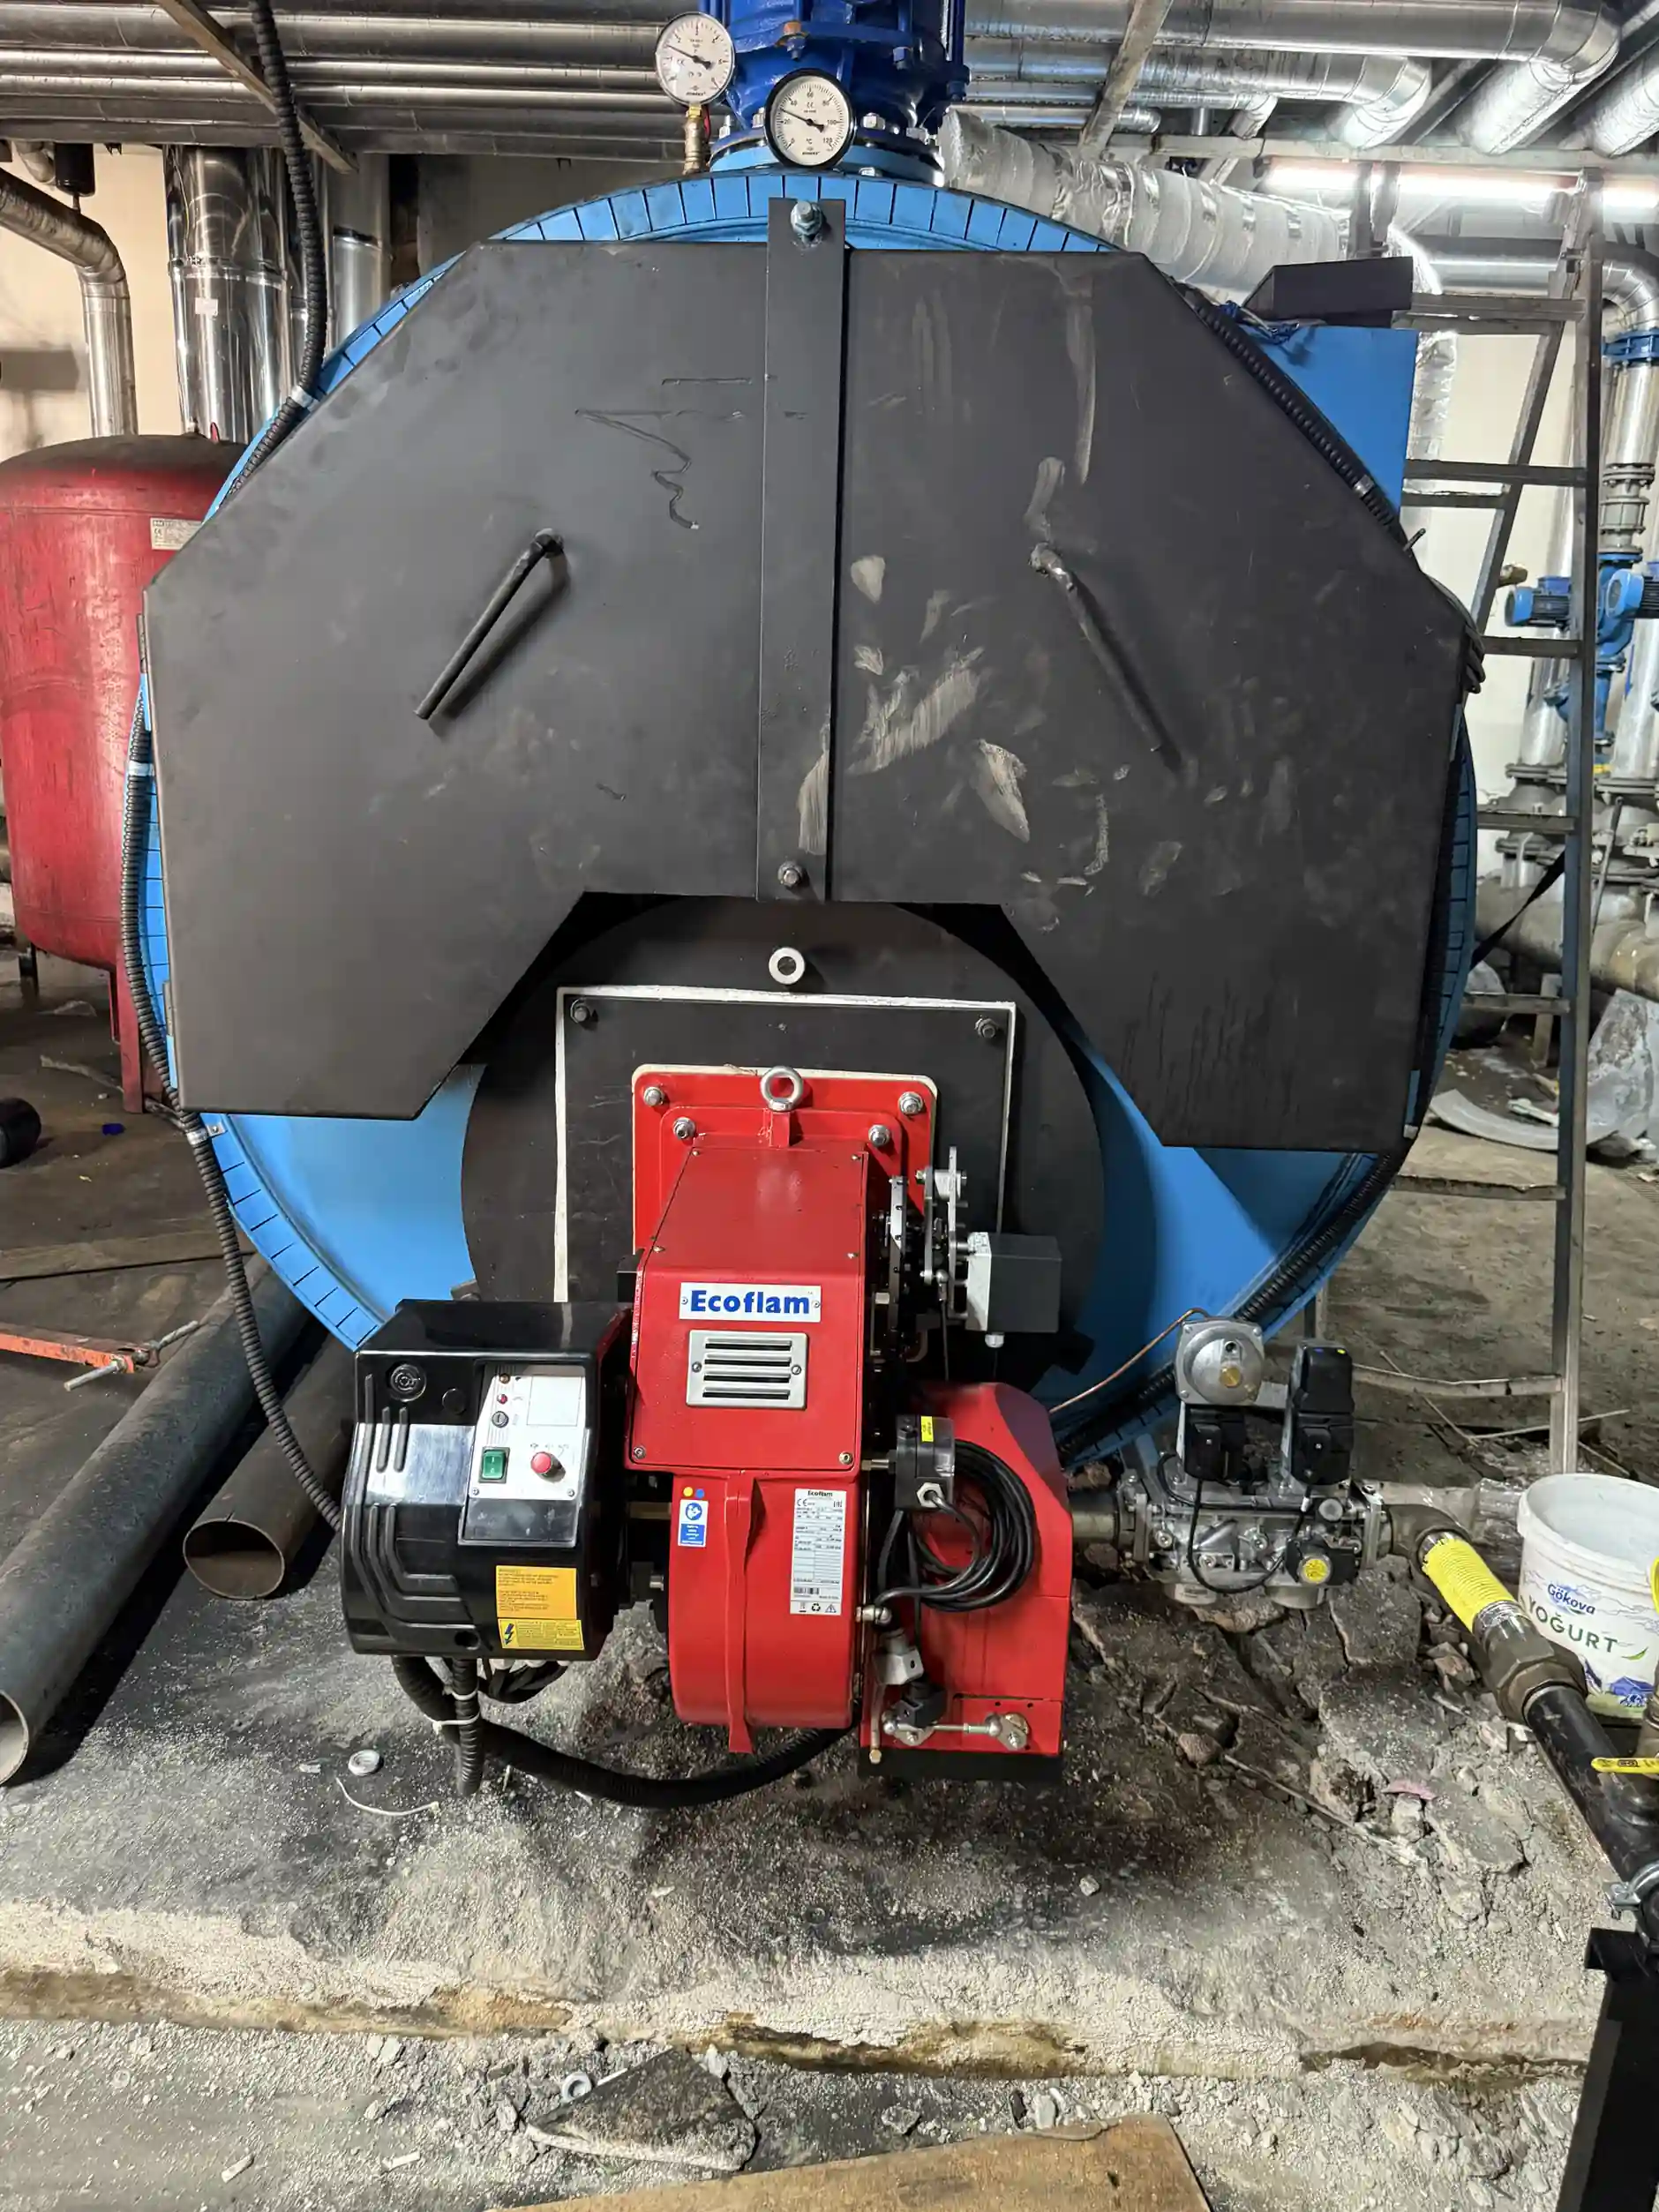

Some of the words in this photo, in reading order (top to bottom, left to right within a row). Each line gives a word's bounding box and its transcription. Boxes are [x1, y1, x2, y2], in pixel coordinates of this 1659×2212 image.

[690, 1289, 810, 1315] Ecoflam
[1547, 1583, 1596, 1615] Gökova
[1528, 1594, 1618, 1653] YOĞURT
